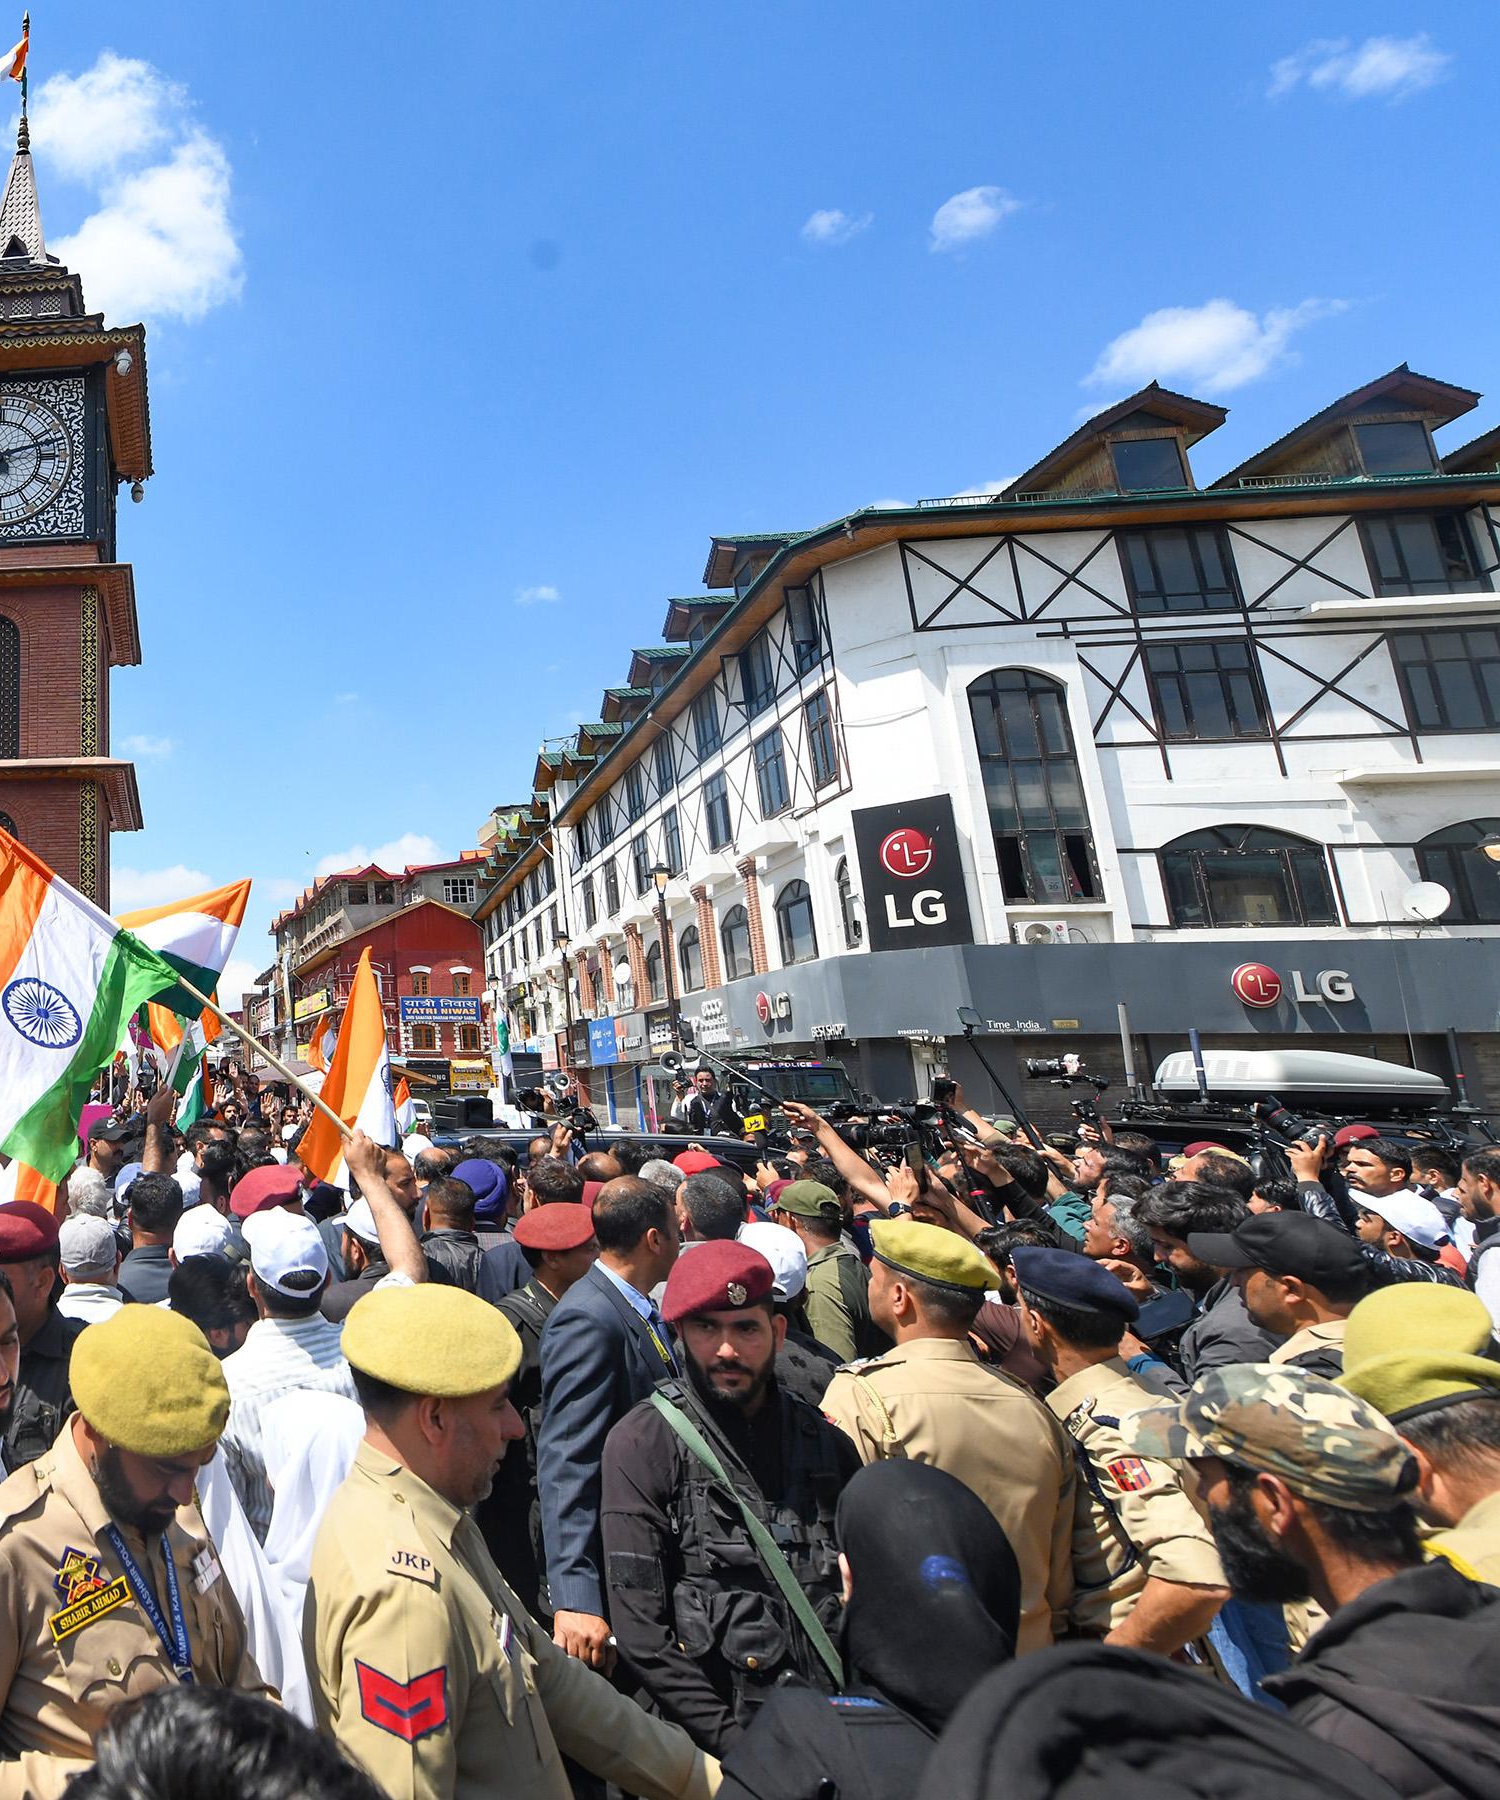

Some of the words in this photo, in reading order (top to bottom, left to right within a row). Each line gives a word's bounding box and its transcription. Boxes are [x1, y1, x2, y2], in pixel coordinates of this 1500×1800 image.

[884, 889, 948, 929] LG
[1291, 969, 1356, 1003] LG
[404, 998, 436, 1007] यात्री
[440, 998, 477, 1007] निवास
[766, 991, 791, 1020] LG
[811, 1025, 826, 1038] BEST
[825, 1023, 847, 1036] SHOP
[986, 1019, 1011, 1029] Time
[1016, 1019, 1040, 1029] India
[391, 1550, 431, 1572] JKP
[130, 1566, 156, 1613] KASHMIR
[60, 1605, 91, 1630] SHABIR
[92, 1588, 120, 1612] AHMAD
[176, 1624, 188, 1665] JAMMU
